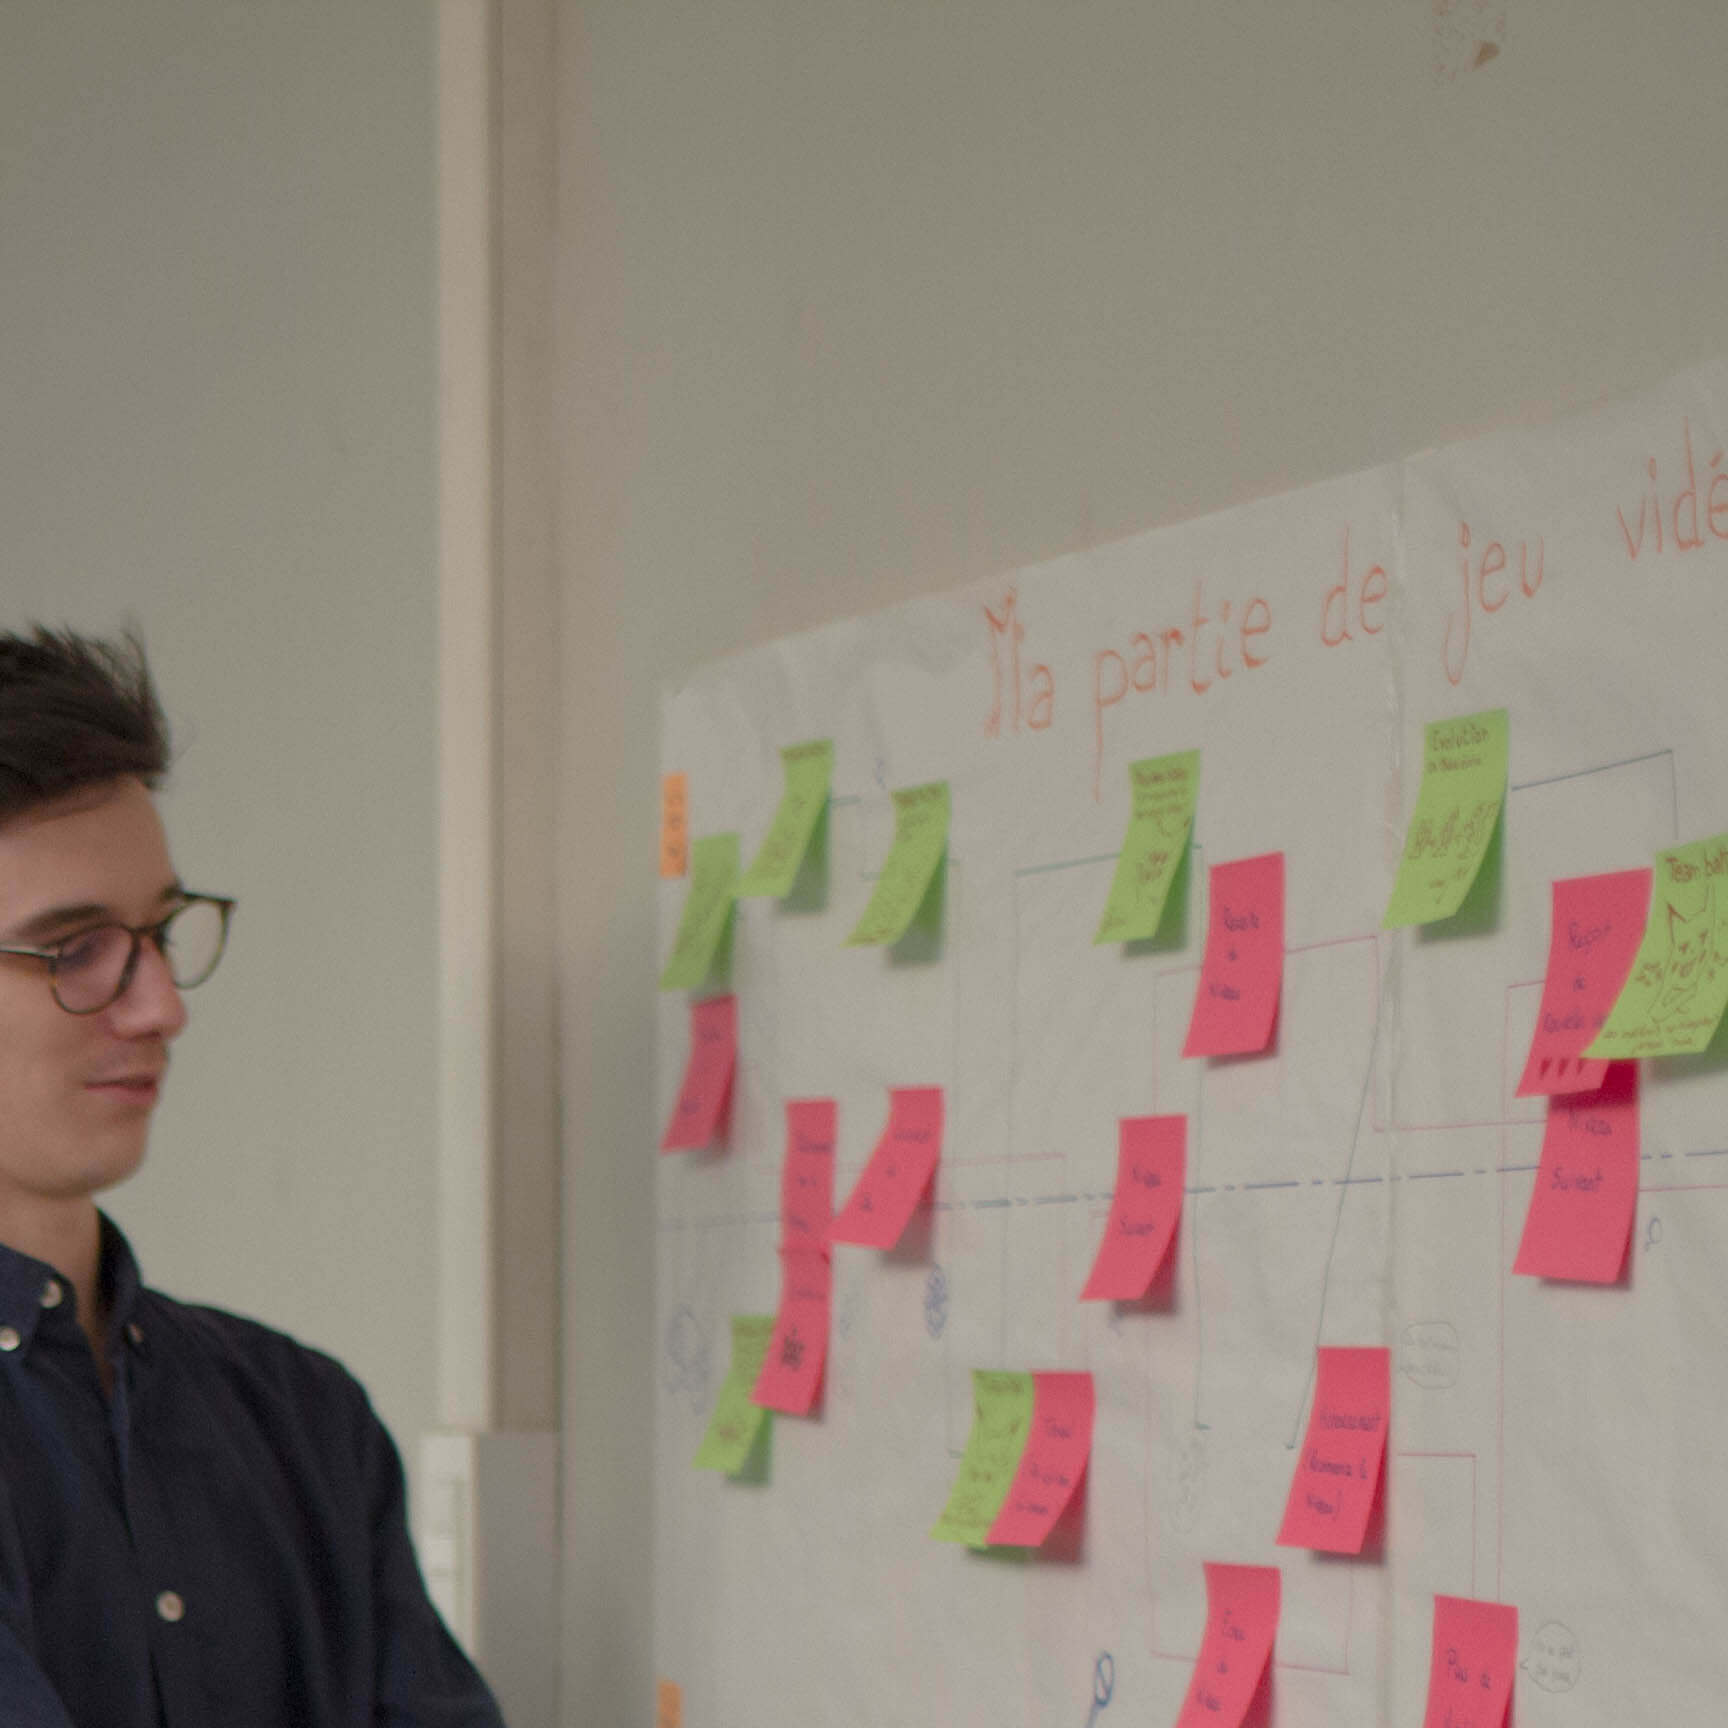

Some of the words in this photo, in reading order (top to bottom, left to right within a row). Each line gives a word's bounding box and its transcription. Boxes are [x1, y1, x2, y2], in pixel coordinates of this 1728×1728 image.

[1092, 578, 1273, 805] partie
[1319, 522, 1390, 649] de
[1443, 520, 1544, 688] jeu
